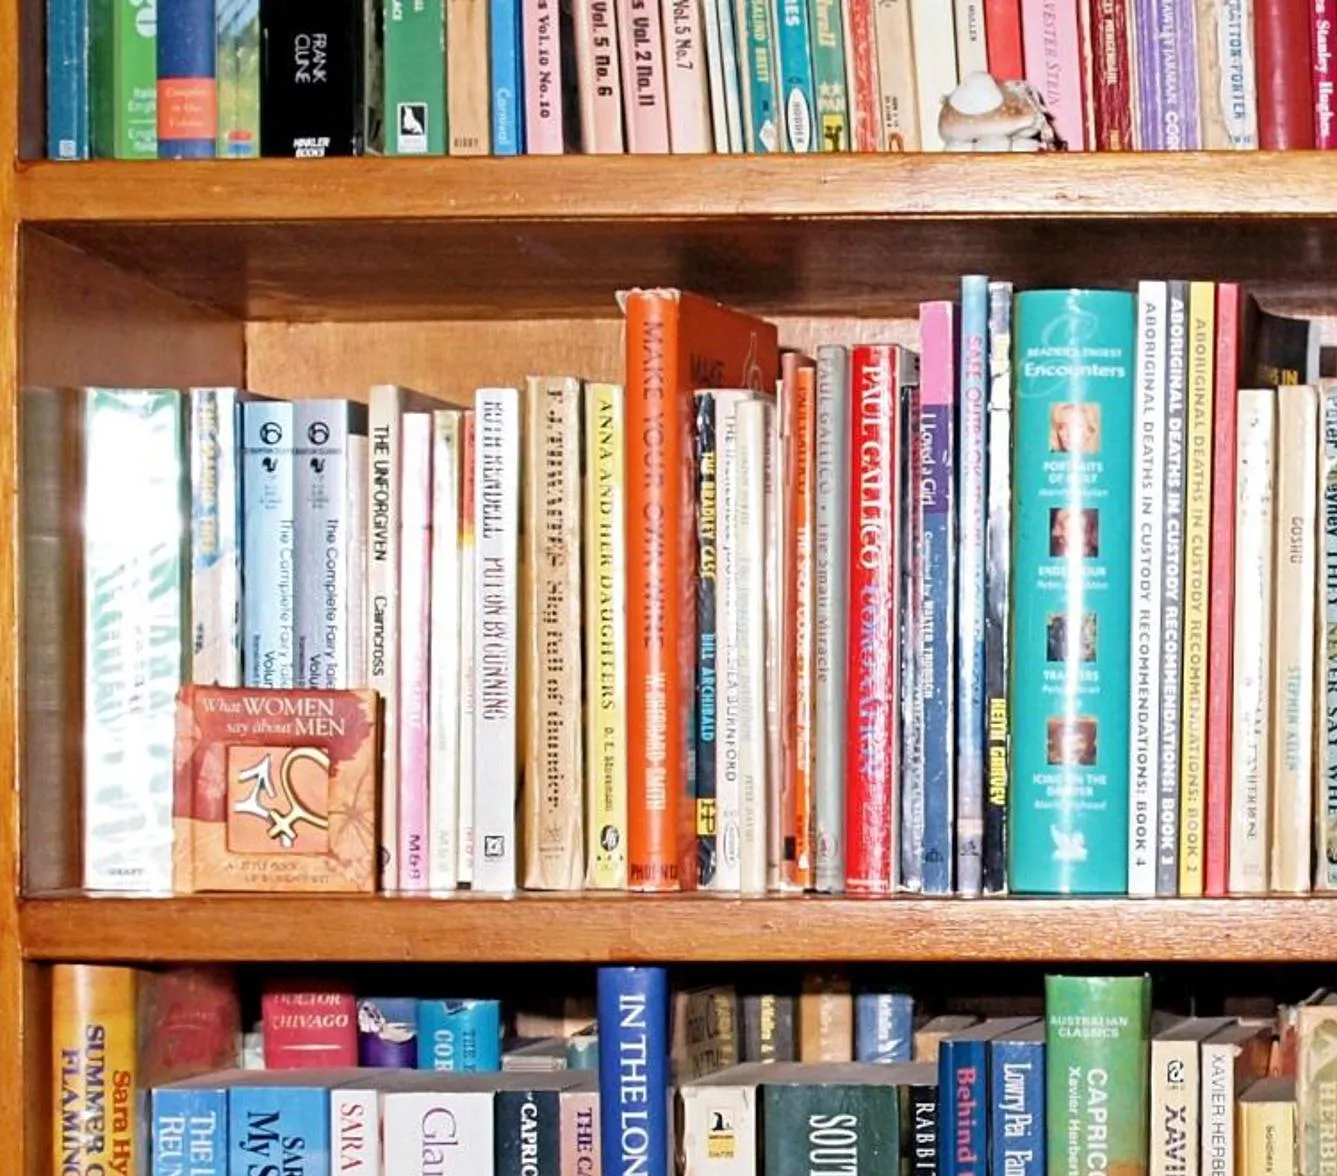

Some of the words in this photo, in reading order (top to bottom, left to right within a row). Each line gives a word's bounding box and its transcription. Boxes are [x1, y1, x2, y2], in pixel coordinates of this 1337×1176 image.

[295, 34, 310, 83] CLUNE
[312, 33, 327, 83] FRANK
[1316, 20, 1331, 74] Stanley
[497, 88, 510, 145] Carnival
[1319, 81, 1334, 137] Hughes
[1142, 302, 1156, 415] ABORIGINAL
[861, 363, 884, 433] PAUL
[1141, 420, 1155, 490] DEATHS
[859, 441, 882, 570] GALLICO
[1140, 495, 1154, 514] IN
[1138, 518, 1153, 602] CUSTODY
[371, 595, 389, 677] Cairncross
[701, 634, 715, 661] BILL
[203, 698, 241, 713] What
[242, 697, 334, 716] WOMEN
[226, 722, 249, 735] say
[252, 720, 291, 733] about
[295, 718, 345, 737] MEN
[701, 667, 715, 742] ARCHIBALD
[990, 699, 1007, 740] KEITH
[1136, 608, 1151, 795] RECOMMENDATIONS:
[990, 746, 1006, 805] GARVEY
[1134, 801, 1148, 852] BOOK
[620, 994, 645, 1029] IN
[620, 1035, 645, 1102] THE
[1003, 1063, 1030, 1111] Lowry
[1067, 1067, 1080, 1114] Xavier
[240, 1111, 277, 1155] My
[1005, 1114, 1030, 1136] Pei
[1067, 1118, 1081, 1176] Herbert
